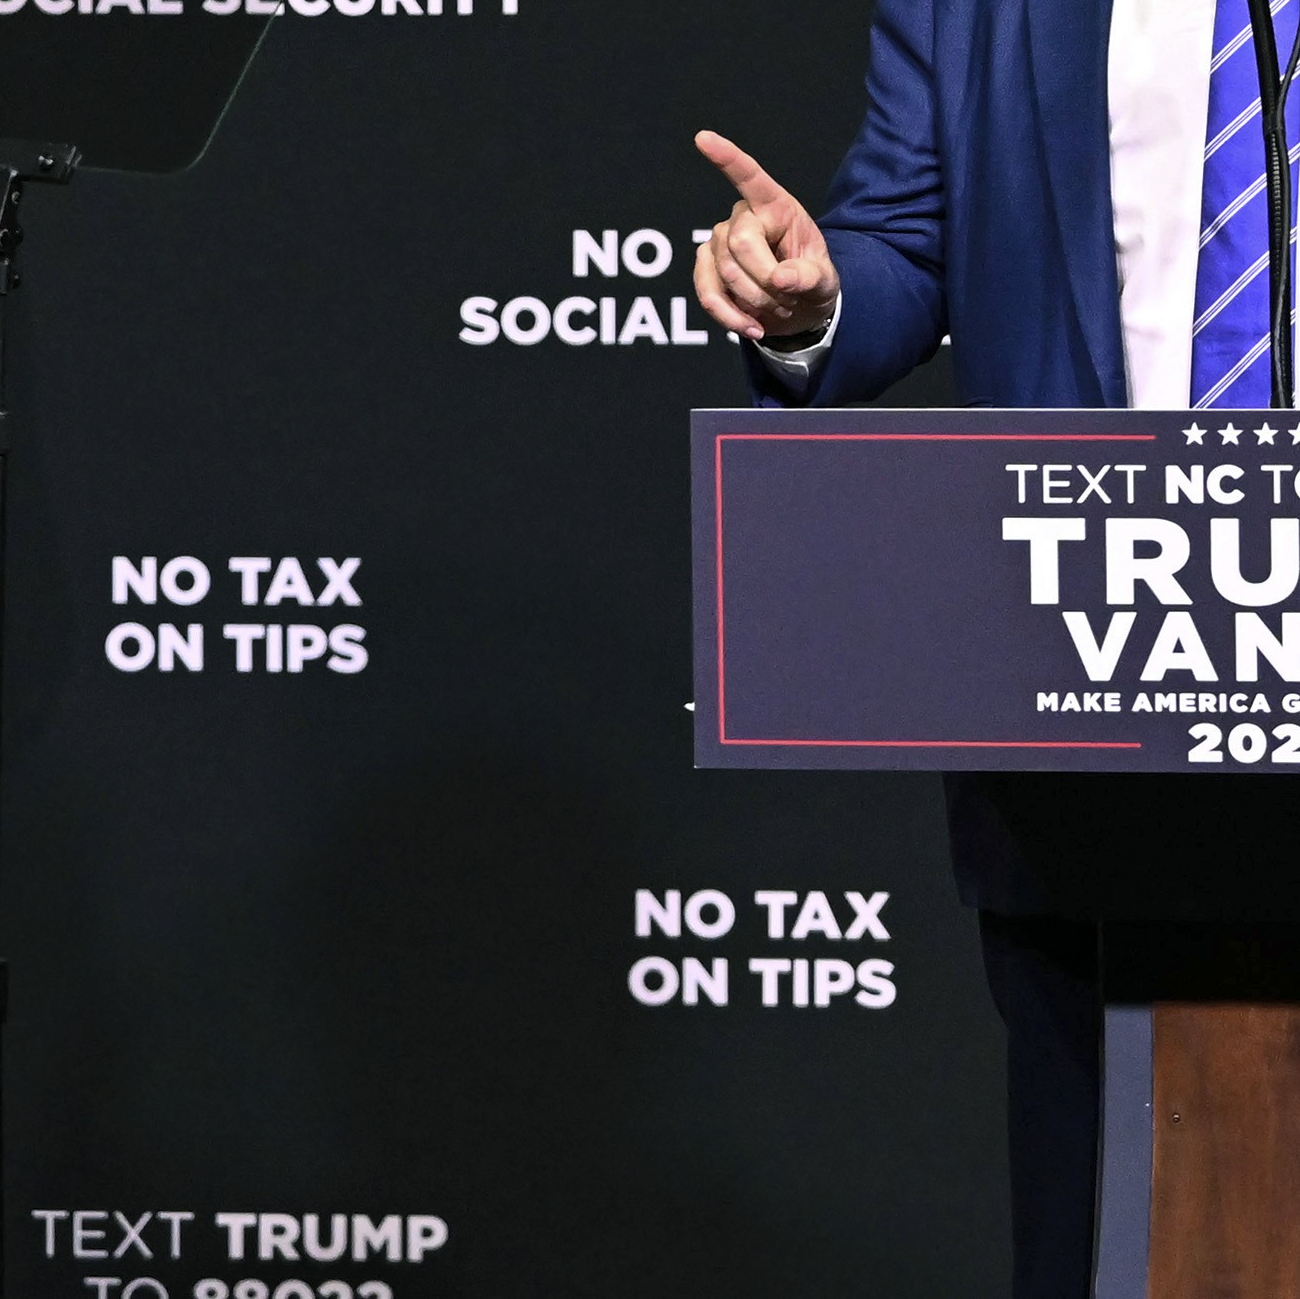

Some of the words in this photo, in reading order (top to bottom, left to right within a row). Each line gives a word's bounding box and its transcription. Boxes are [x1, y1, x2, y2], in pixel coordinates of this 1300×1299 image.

[572, 228, 673, 278] NO
[458, 296, 708, 346] SOCIAL
[1004, 463, 1147, 505] TEXT
[1164, 463, 1246, 505] NC
[112, 555, 211, 606] NO
[228, 556, 362, 607] TAX
[104, 621, 204, 672] ON
[222, 623, 369, 674] TIPS
[1036, 691, 1122, 713] MAKE
[1131, 692, 1272, 714] AMERICA
[635, 889, 736, 939] NO
[754, 890, 891, 940] TAX
[628, 956, 729, 1007] ON
[748, 958, 897, 1009] TIPS
[31, 1209, 196, 1258] TEXT
[214, 1211, 449, 1263] TRUMP
